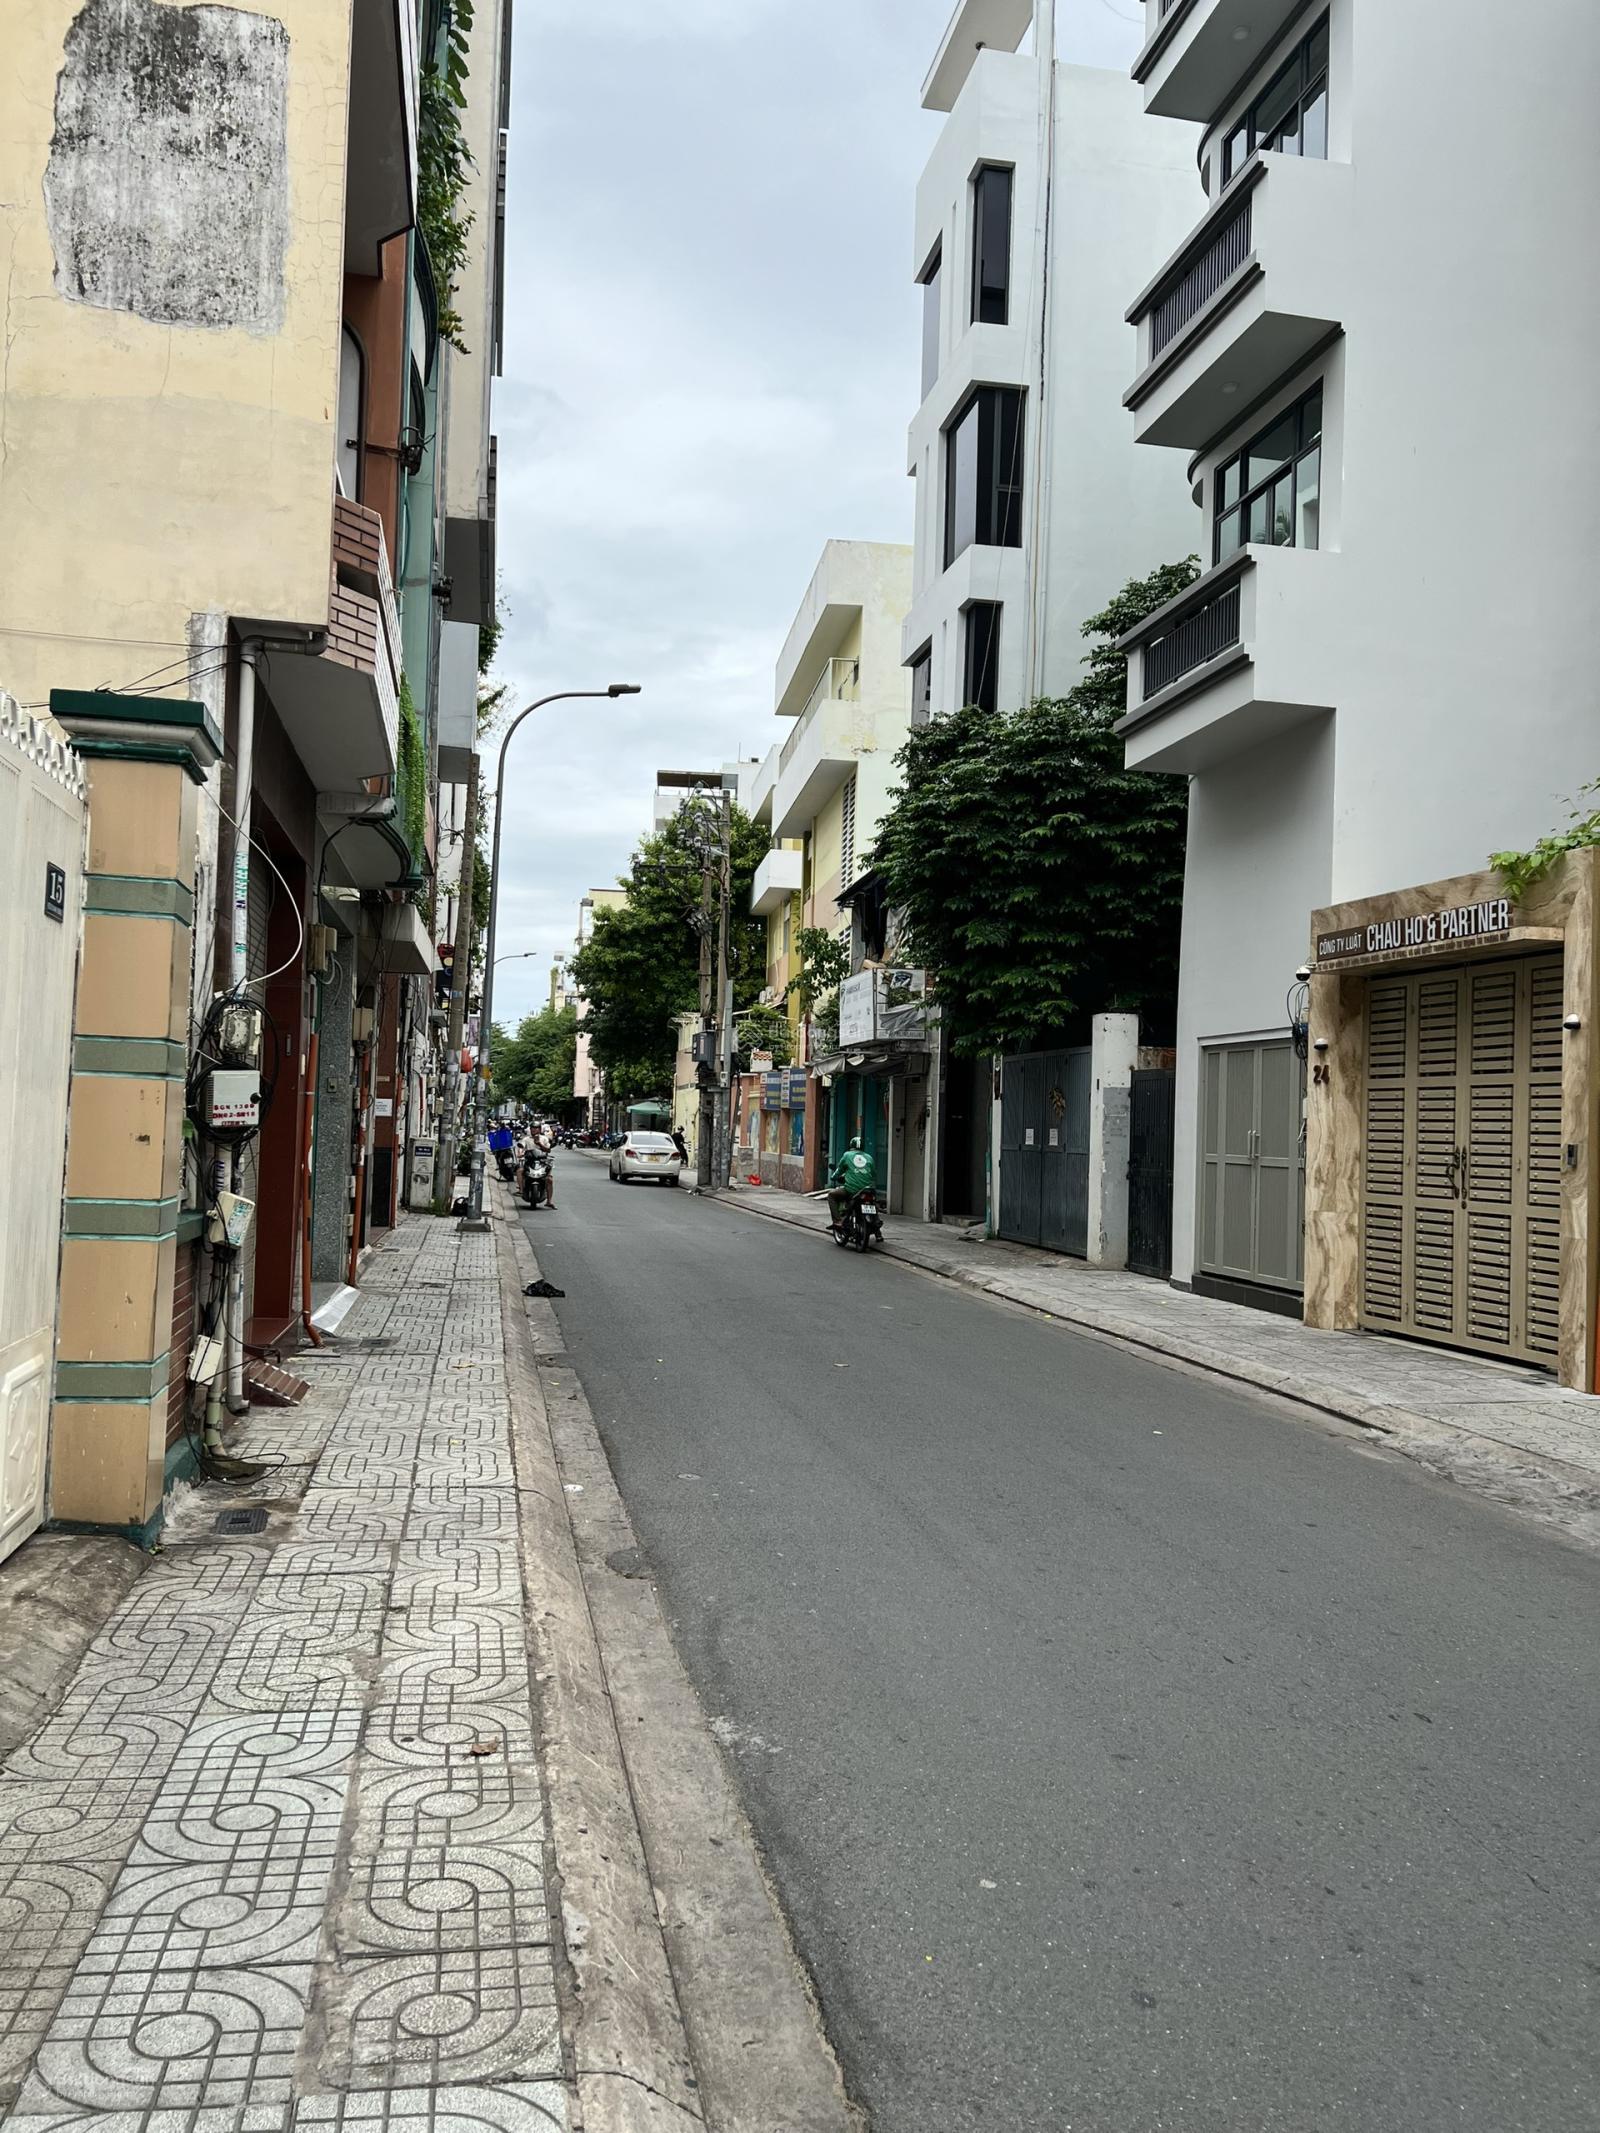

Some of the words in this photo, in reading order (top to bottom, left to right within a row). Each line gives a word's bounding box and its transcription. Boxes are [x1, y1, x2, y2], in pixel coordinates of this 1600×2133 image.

[49, 871, 63, 904] 15
[1319, 938, 1336, 956] CÔNG
[1336, 937, 1345, 952] TY
[1345, 932, 1362, 952] LUẬT
[1366, 918, 1401, 952] CHAU
[1405, 916, 1424, 946] HO
[1427, 913, 1436, 941] &
[1440, 898, 1509, 940] PARTNER
[1313, 1064, 1330, 1086] 24
